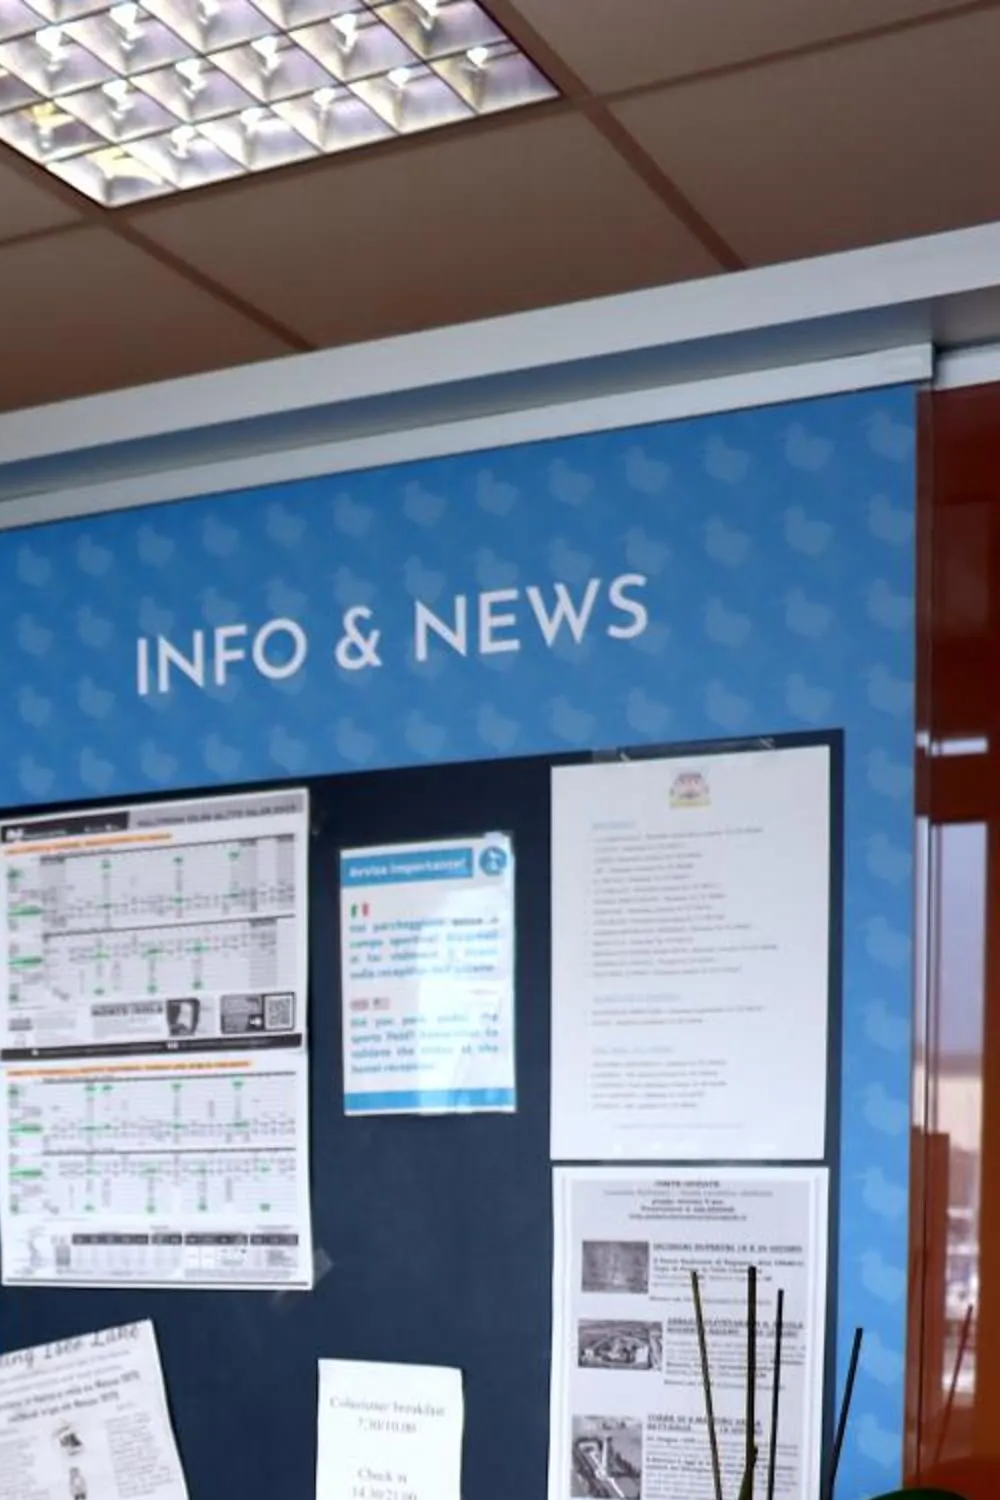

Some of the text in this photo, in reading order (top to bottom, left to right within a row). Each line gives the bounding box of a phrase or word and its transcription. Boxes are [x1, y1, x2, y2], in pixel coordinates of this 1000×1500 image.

[136, 573, 649, 696] INFO & NEWS
